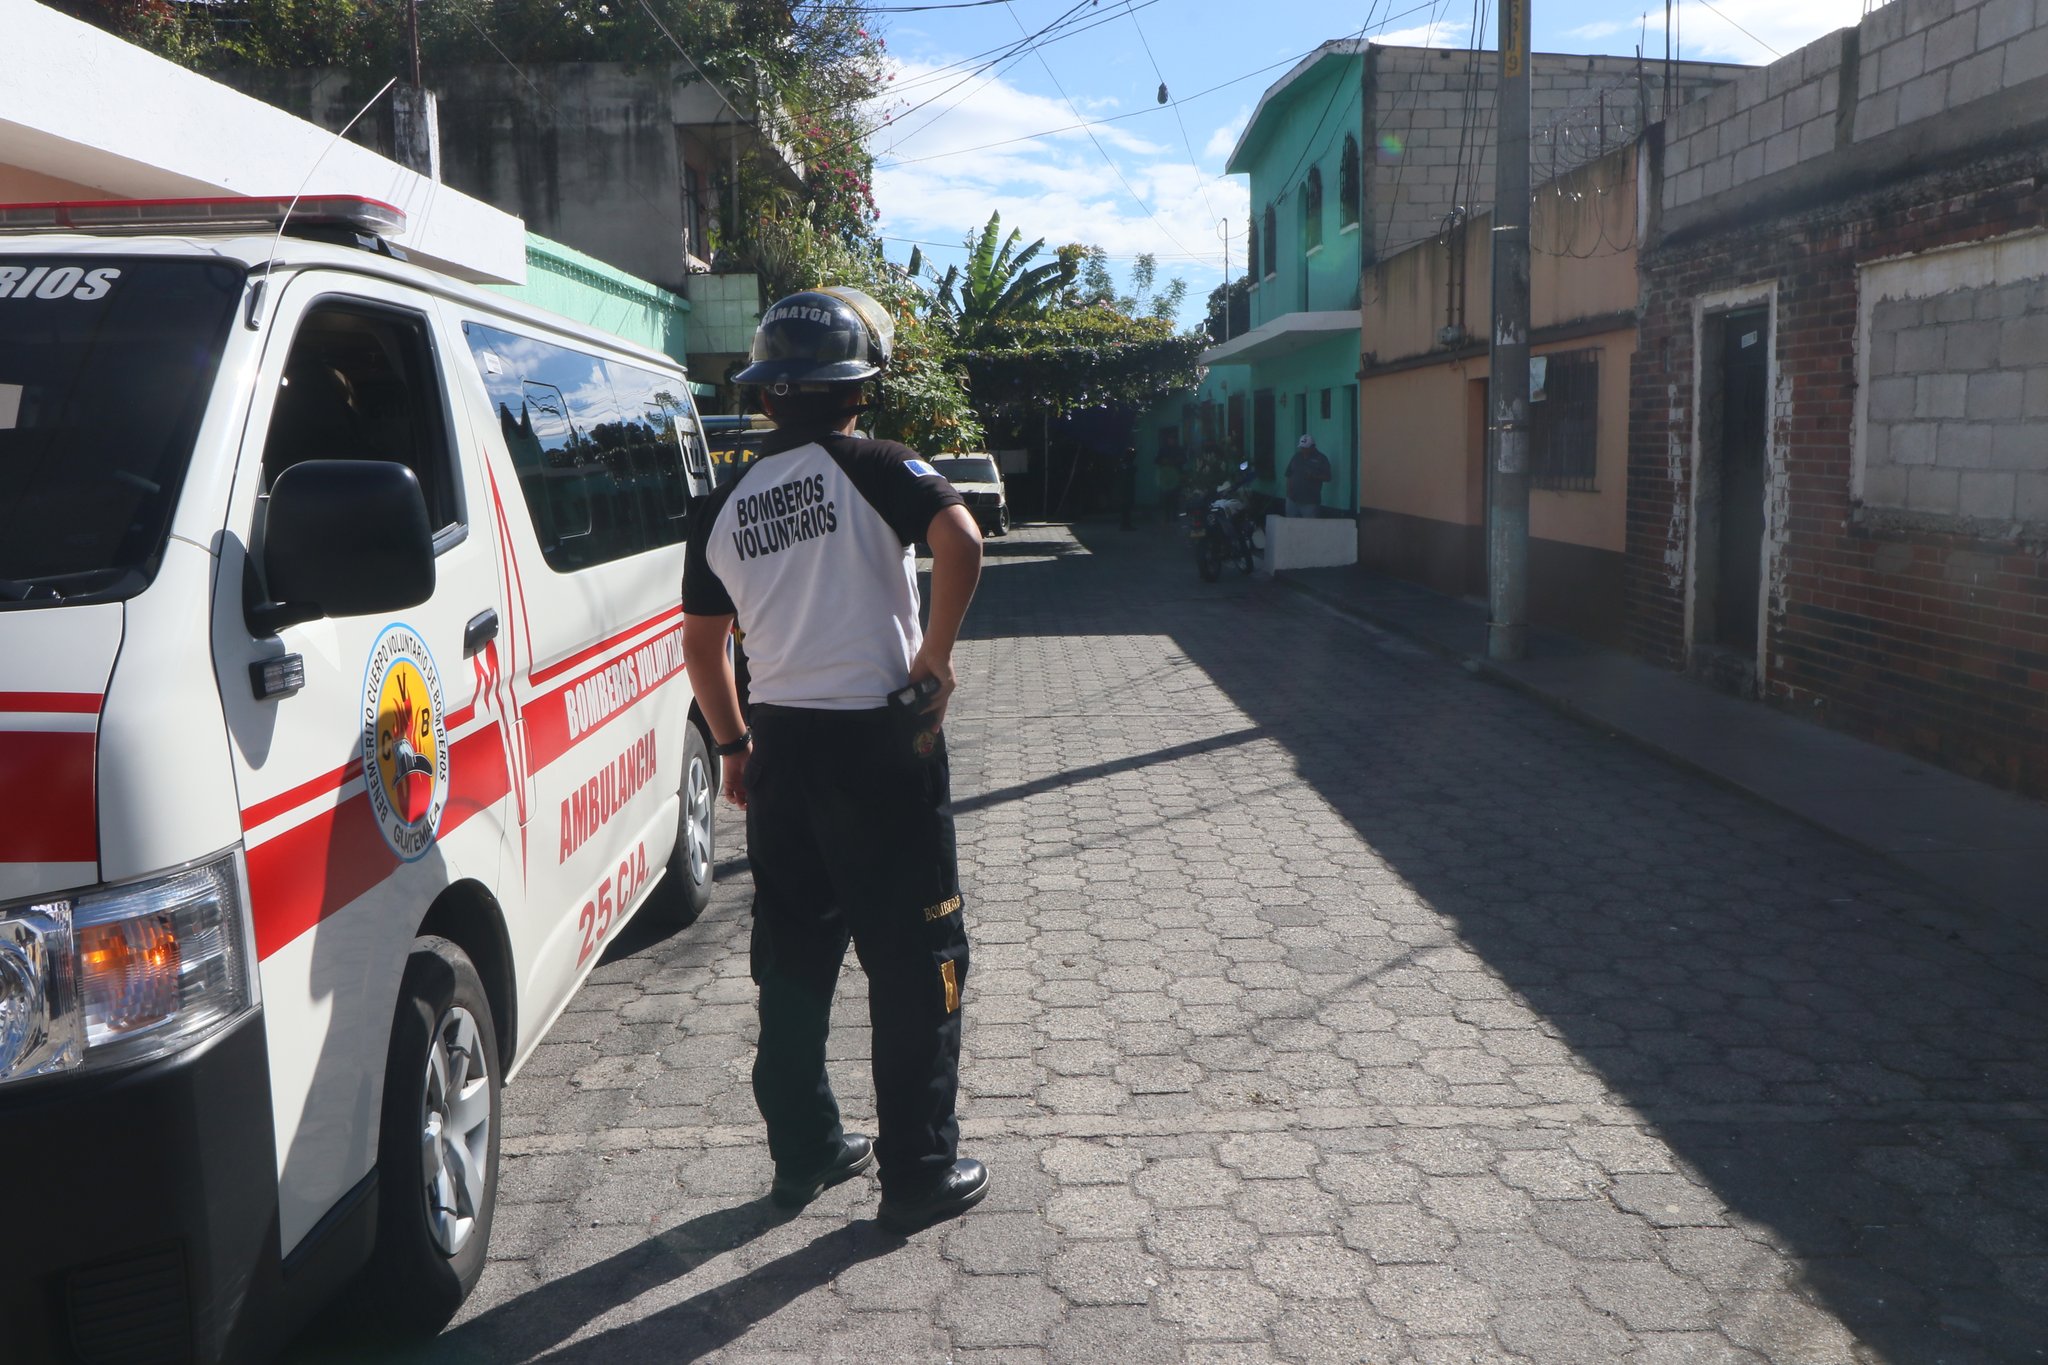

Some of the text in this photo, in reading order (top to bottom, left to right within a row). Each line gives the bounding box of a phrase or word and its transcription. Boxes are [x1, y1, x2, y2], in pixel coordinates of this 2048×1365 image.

[732, 501, 837, 561] VOLUNTARIOS
[736, 473, 824, 528] BOMBEROS
[364, 632, 447, 824] BENEMERITO CUERPO VOLUNTARIO DE BOMBEROS
[564, 655, 638, 740] BOMBEROS
[393, 801, 441, 854] GUATEMALA
[559, 728, 657, 865] AMBULANCIA
[576, 841, 649, 970] 25 CIA.
